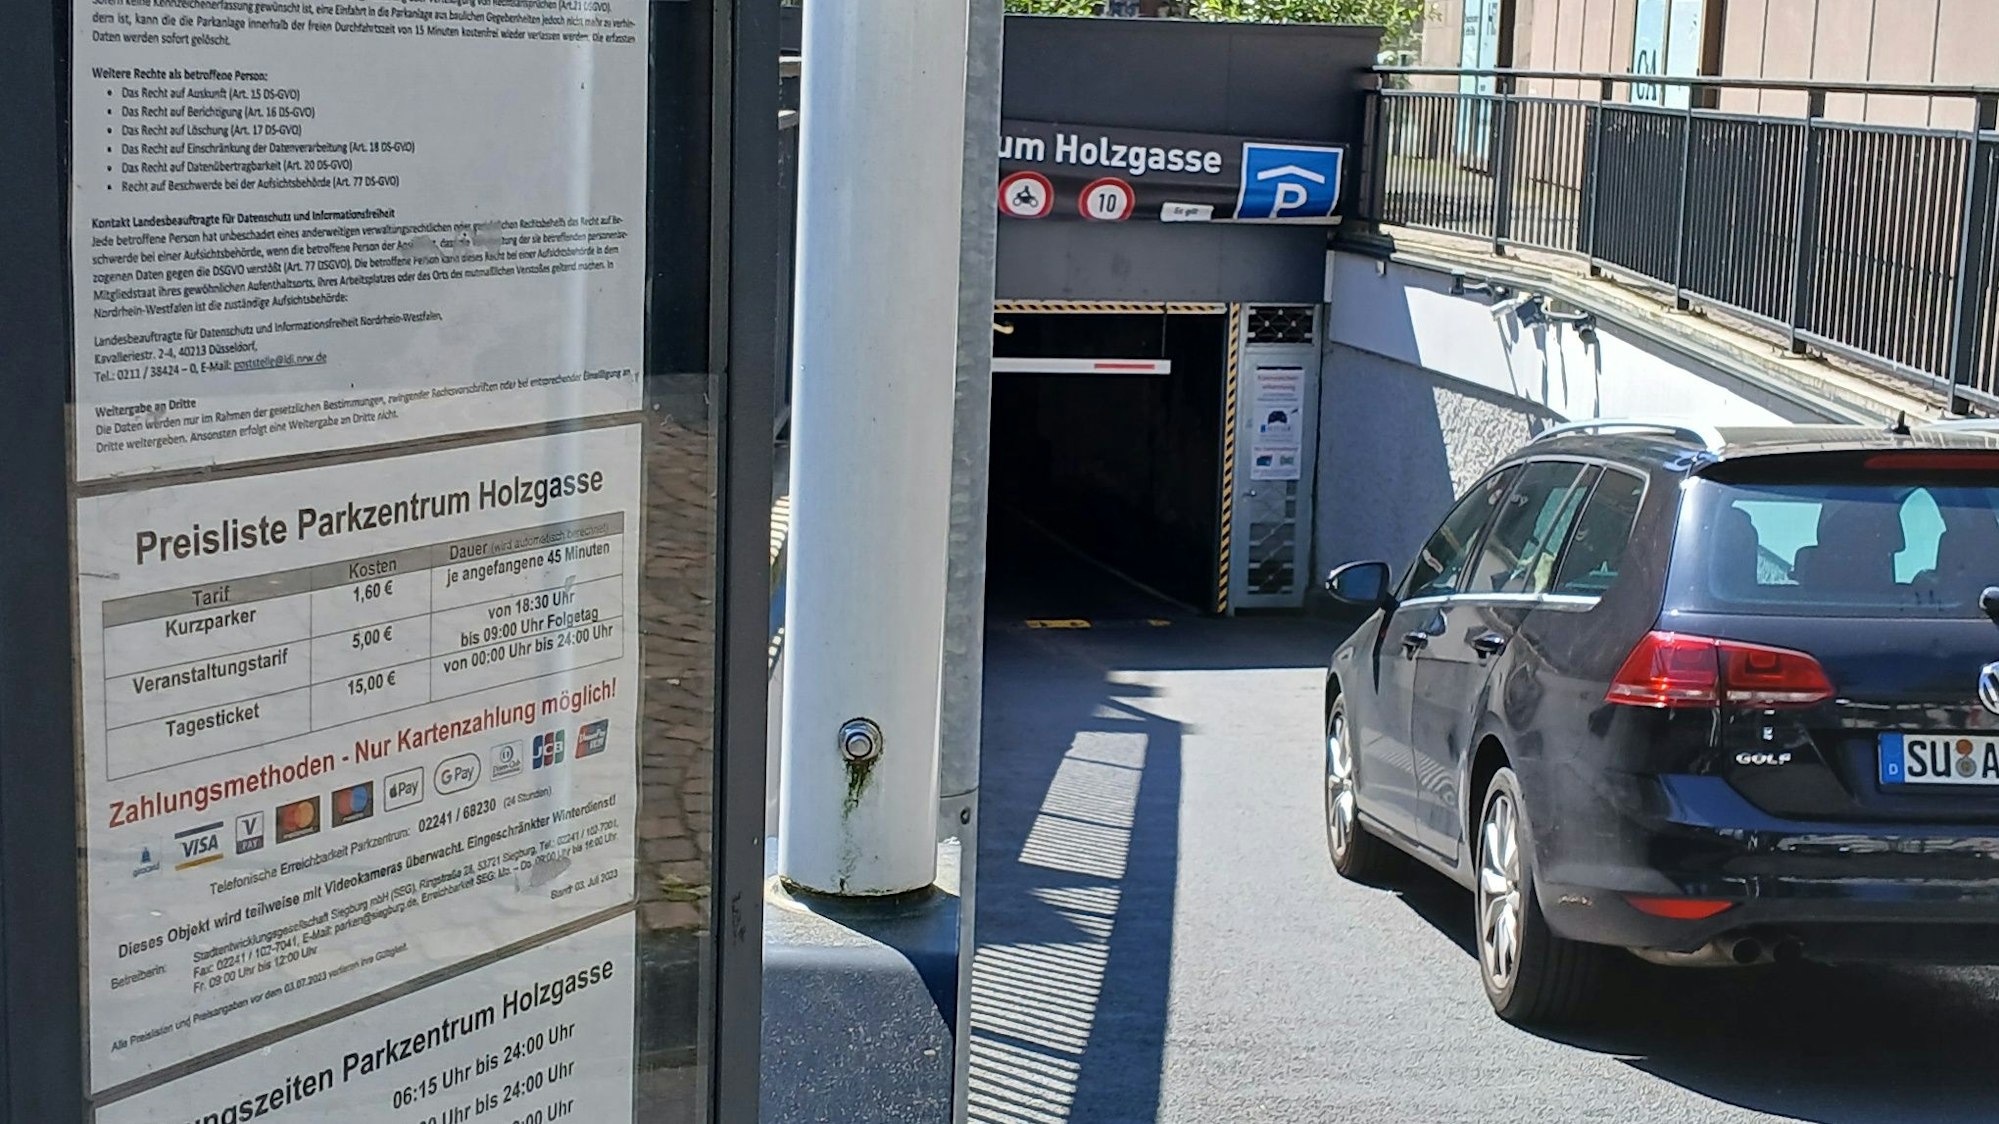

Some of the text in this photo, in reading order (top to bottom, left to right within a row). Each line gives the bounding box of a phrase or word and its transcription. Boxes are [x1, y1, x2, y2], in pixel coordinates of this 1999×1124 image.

[92, 31, 121, 42] Daten
[122, 32, 159, 43] werden
[161, 33, 190, 44] sofort
[92, 67, 268, 82] Weitere Rechte als betroffene Person:
[122, 87, 140, 99] Das
[141, 87, 168, 99] Recht
[170, 87, 185, 99] auf
[187, 87, 227, 100] Auskunft
[228, 88, 249, 101] (Art.
[122, 106, 315, 121] Das Recht auf Berichtigung (Art. 16 DS-GVO)
[1055, 133, 1222, 176] Holzgasse
[1098, 193, 1117, 213] 10
[1269, 182, 1308, 218] P
[92, 207, 395, 229] Kontakt Landesbeauftragte für Datenschutz und Informationsfreiheit
[209, 341, 258, 356] Düsseldorf,
[116, 368, 141, 380] 0211
[151, 364, 180, 378] 38424
[95, 402, 153, 419] Weitergabe
[169, 398, 197, 411] Dritte
[136, 470, 603, 565] Preisliste Parkzentrum Holzgasse
[166, 542, 610, 638] Kurzparker 1,60 € je angefangene 45 Minuten
[192, 542, 488, 606] Tarif Kosten Dauer
[132, 591, 576, 694] Veranstaltungstarif 5,00 € von 18:30 Uhr
[461, 608, 599, 647] bis 09:00 Uhr Folgetag
[166, 622, 614, 737] Tagesticket 15,00 € von 00:00 Uhr bis 24:00 Uhr
[109, 754, 334, 828] Zahlungsmethoden
[355, 736, 391, 764] Nur
[398, 702, 536, 748] Kartenzahlung
[541, 677, 617, 716] möglich!
[1735, 752, 1791, 765] GOLF
[1888, 763, 1899, 776] D
[1907, 740, 1951, 777] SU
[399, 780, 419, 798] Pay
[454, 762, 475, 782] Pay
[241, 817, 258, 835] V
[182, 833, 219, 858] VISA
[210, 866, 277, 895] Telefonische
[280, 845, 348, 876] Erreichbarkeit
[351, 828, 410, 857] Parkzentrum:
[418, 811, 454, 833] 02241
[463, 798, 497, 819] 68230
[118, 794, 617, 959] Dieses Objekt wird teilweise mit Videokameras überwacht. Eingeschränkter Winterdienst!
[111, 963, 167, 990] Betreiberin:
[331, 902, 369, 922] Siegburg
[371, 893, 390, 911] mbH
[216, 953, 247, 972] 02241
[238, 965, 256, 979] Uhr
[257, 960, 271, 974] bis
[274, 951, 299, 969] 12:00
[301, 945, 319, 961] Uhr
[343, 1006, 494, 1082] Parkzentrum
[503, 960, 613, 1019] Holzgasse
[393, 1023, 576, 1109] 06:15 Uhr bis 24:00 Uhr
[443, 1106, 471, 1124] Uhr
[475, 1093, 499, 1116] bis
[503, 1071, 544, 1103] 24:00
[548, 1061, 575, 1083] Uhr
[548, 1098, 575, 1122] Uhr
